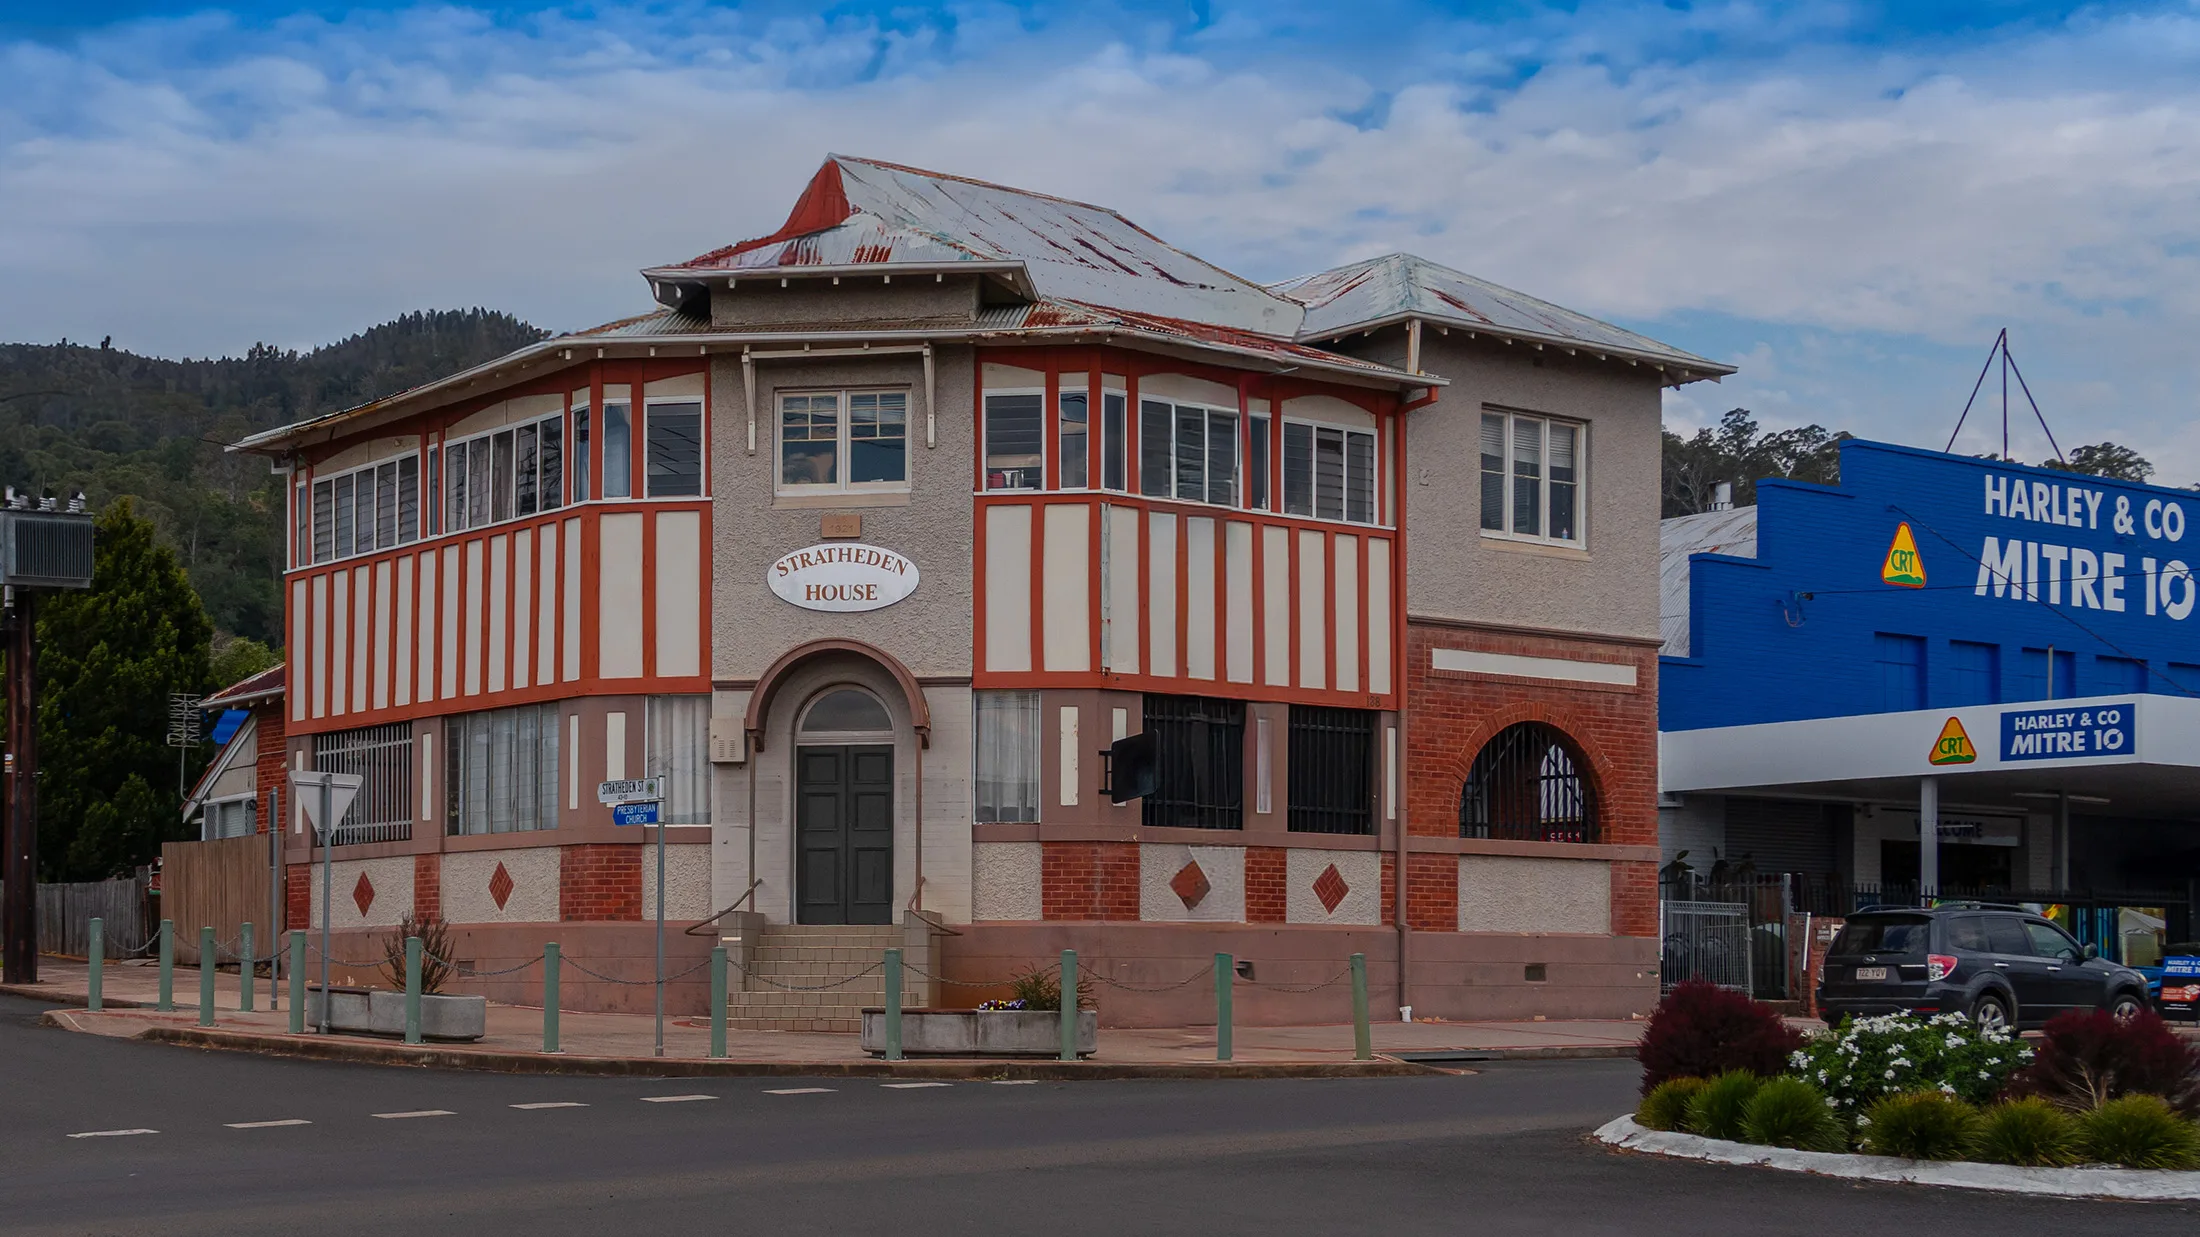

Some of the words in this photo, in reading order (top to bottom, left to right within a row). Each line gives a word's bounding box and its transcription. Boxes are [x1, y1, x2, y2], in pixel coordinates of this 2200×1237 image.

[1985, 474, 2104, 530] HARLEY
[2113, 495, 2135, 536] &
[2145, 499, 2185, 542] CO
[776, 547, 908, 577] STRATHEDEN
[1890, 549, 1915, 574] CRT
[1974, 536, 2125, 613] MITRE
[2142, 557, 2196, 621] 10
[805, 584, 878, 601] HOUSE
[2014, 712, 2075, 731] HARLEY
[2080, 712, 2092, 726] &
[2097, 710, 2121, 726] CO
[1939, 736, 1965, 755] CRT
[2010, 731, 2086, 755] MITRE
[2094, 728, 2124, 750] 10
[602, 781, 636, 795] STRATHEDEN
[637, 780, 644, 792] ST
[617, 804, 655, 815] PRESBYTERIAN
[625, 814, 647, 824] CHURCH
[1914, 818, 1983, 838] WLCOME
